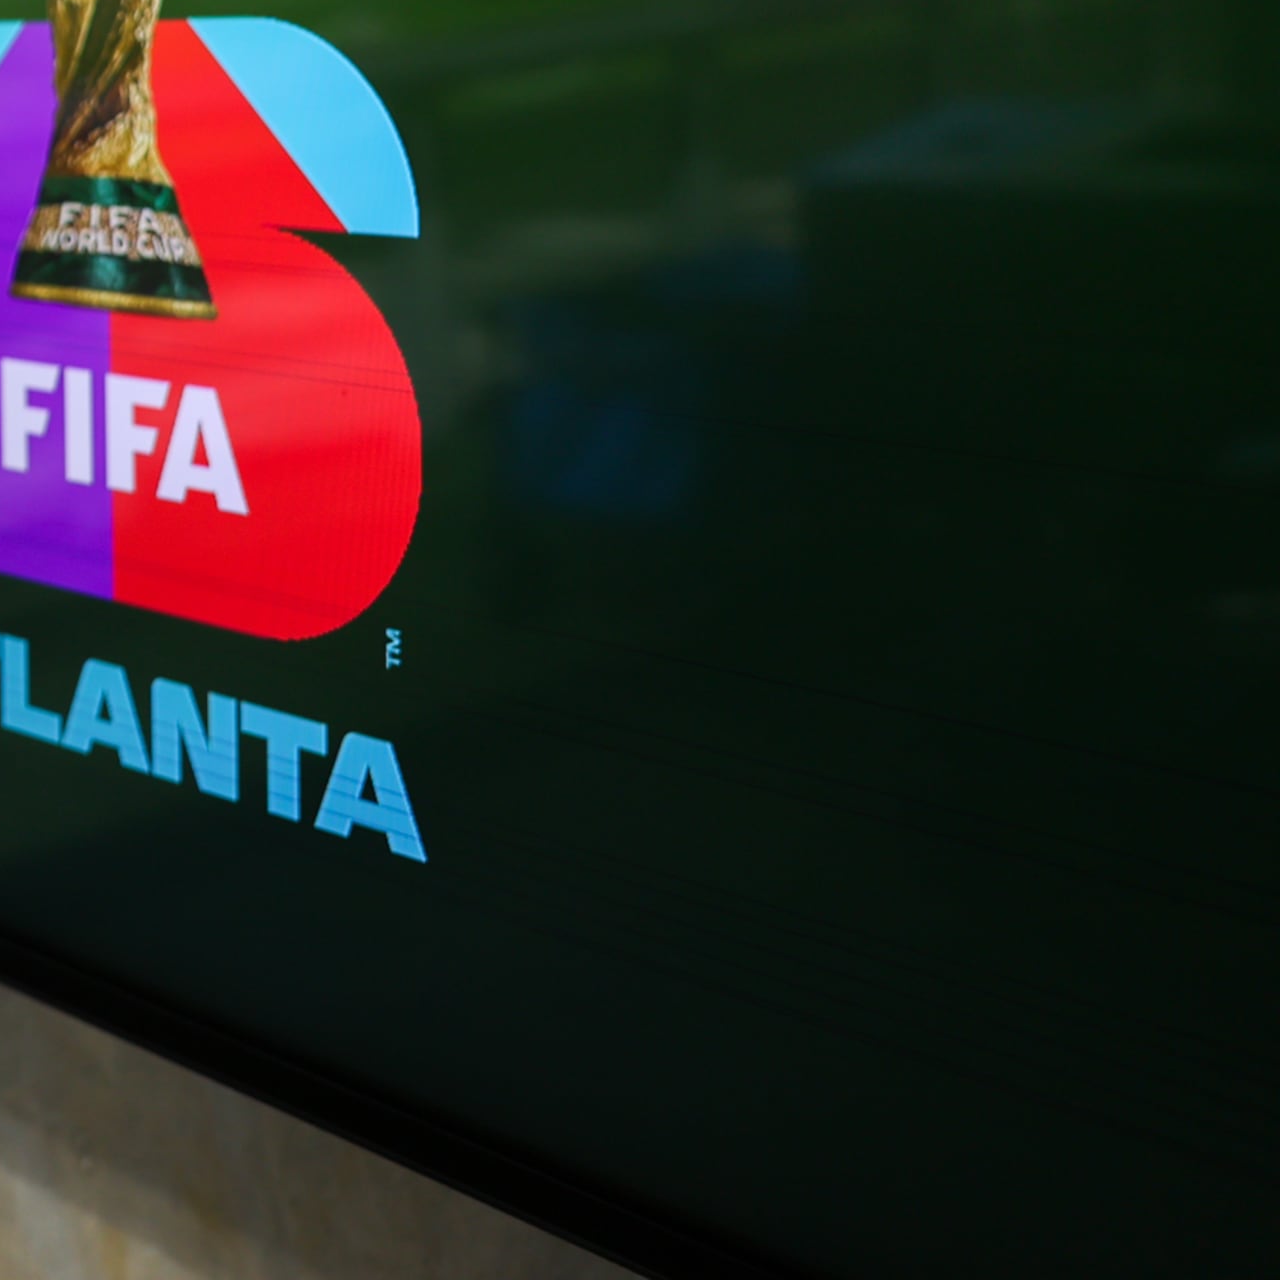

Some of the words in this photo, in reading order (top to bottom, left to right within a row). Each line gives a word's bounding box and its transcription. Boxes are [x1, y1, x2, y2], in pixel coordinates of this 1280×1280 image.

[59, 201, 163, 234] FIFA
[41, 226, 129, 255] WORLD
[0, 357, 249, 516] FIFA
